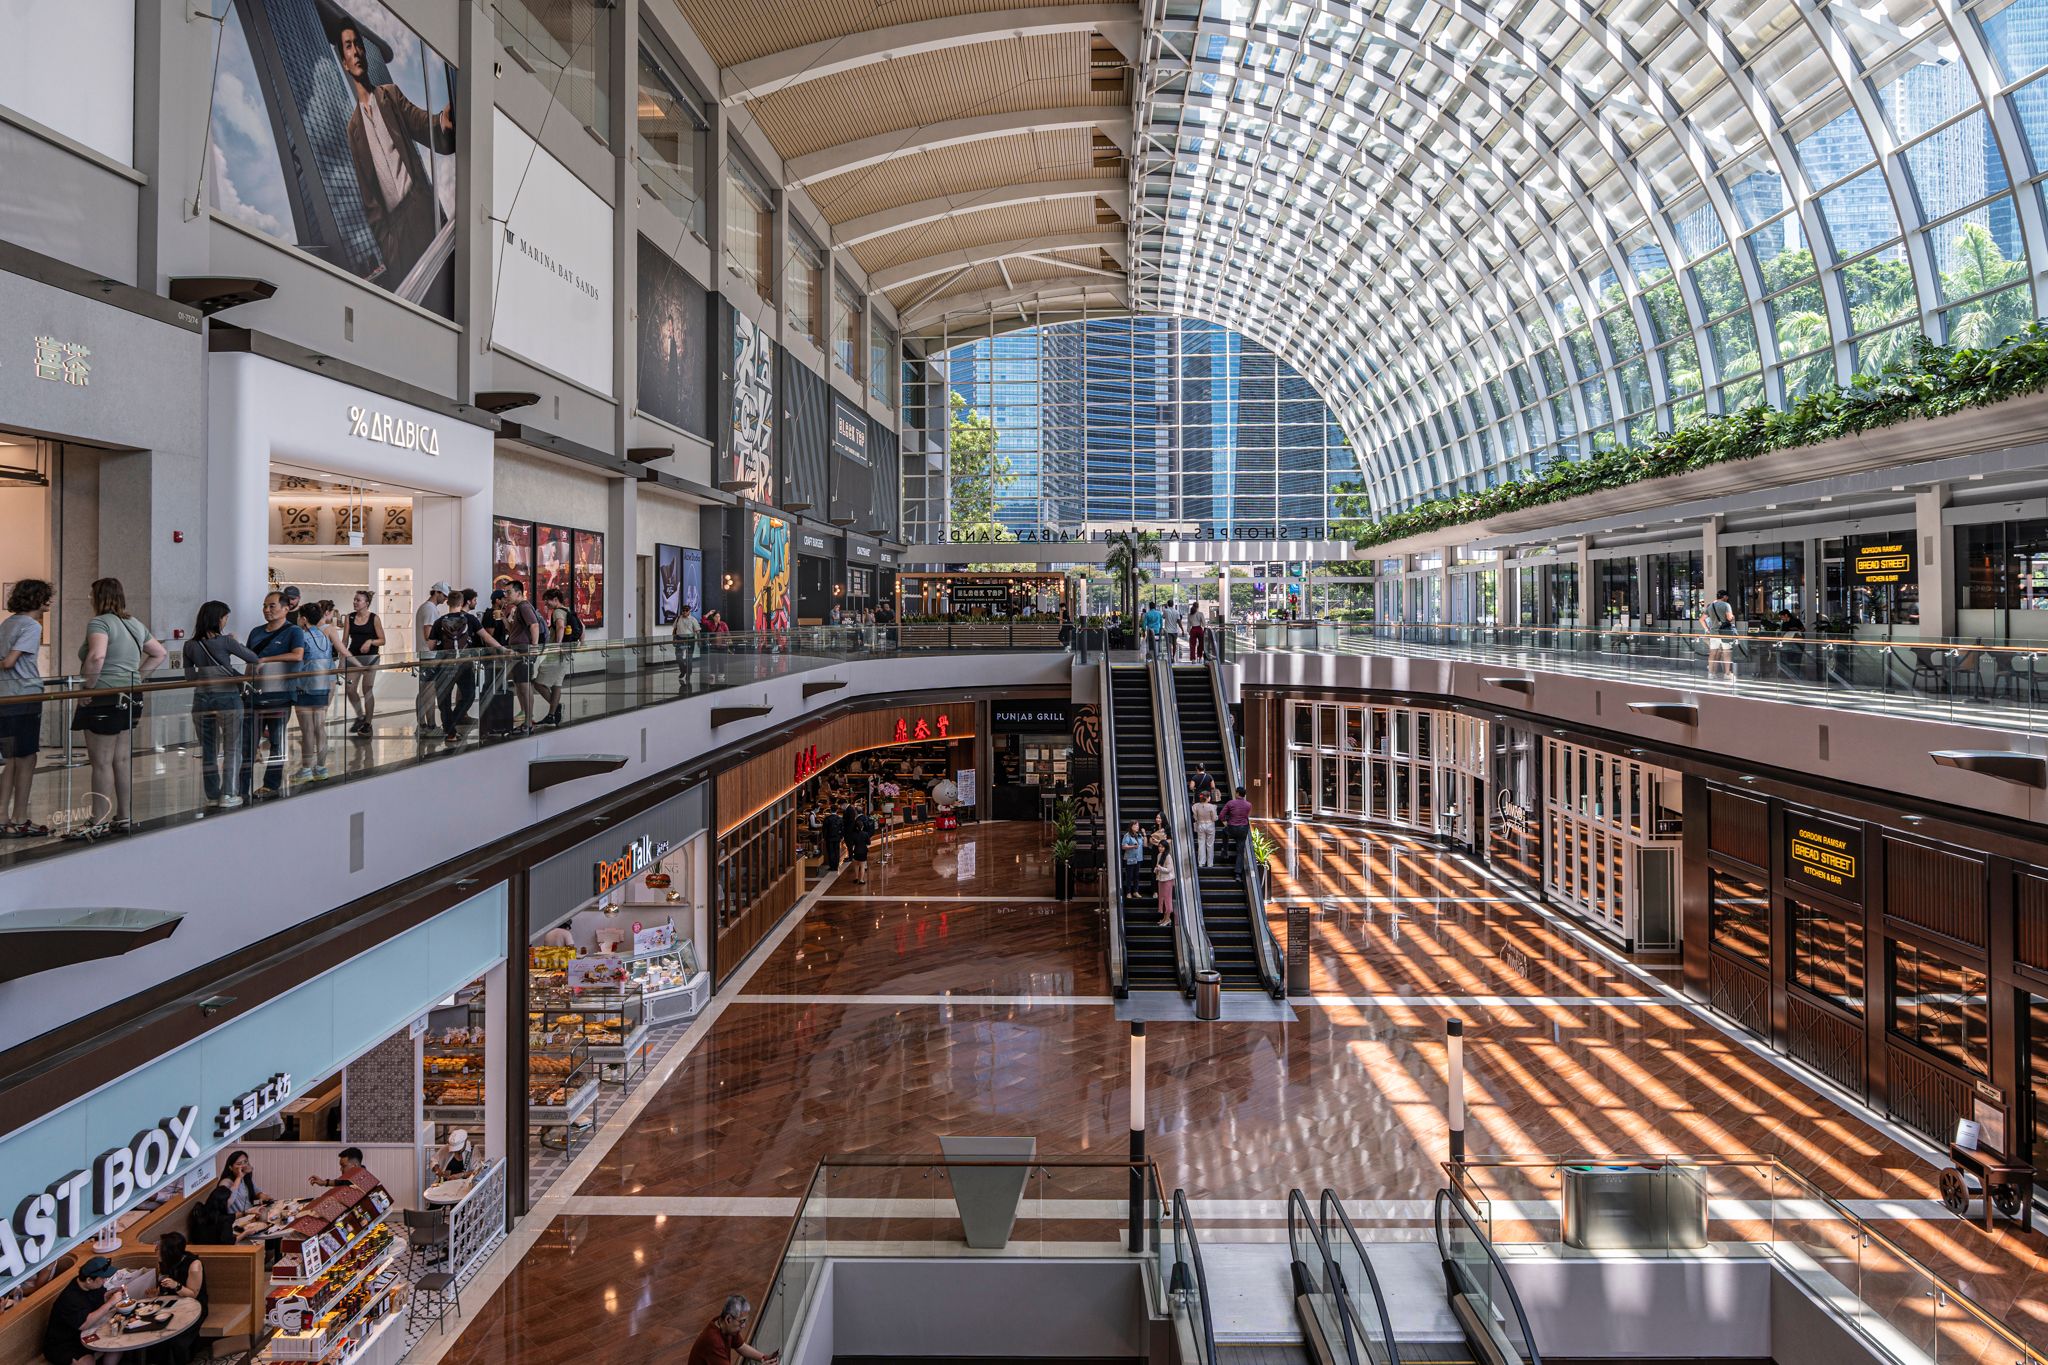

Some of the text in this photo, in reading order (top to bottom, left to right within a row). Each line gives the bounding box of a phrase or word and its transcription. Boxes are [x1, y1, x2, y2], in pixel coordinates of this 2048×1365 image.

[520, 238, 599, 301] MARINA BAY SANDS
[34, 335, 91, 386] 喜茶
[369, 411, 440, 456] ARABICA
[838, 416, 865, 448] BLACK TAP
[1858, 558, 1907, 570] BREAD STREET
[957, 589, 1004, 597] BLACK TAP
[996, 712, 1033, 722] PUNJAB
[1799, 829, 1846, 849] GORDON RAMSAY
[599, 834, 652, 893] BreadTalk
[1795, 844, 1851, 871] BREAD STREET
[1804, 866, 1826, 879] KITCHEN
[1830, 874, 1842, 885] BAR
[218, 1072, 291, 1138] 土司工坊
[100, 1105, 200, 1216] BOX
